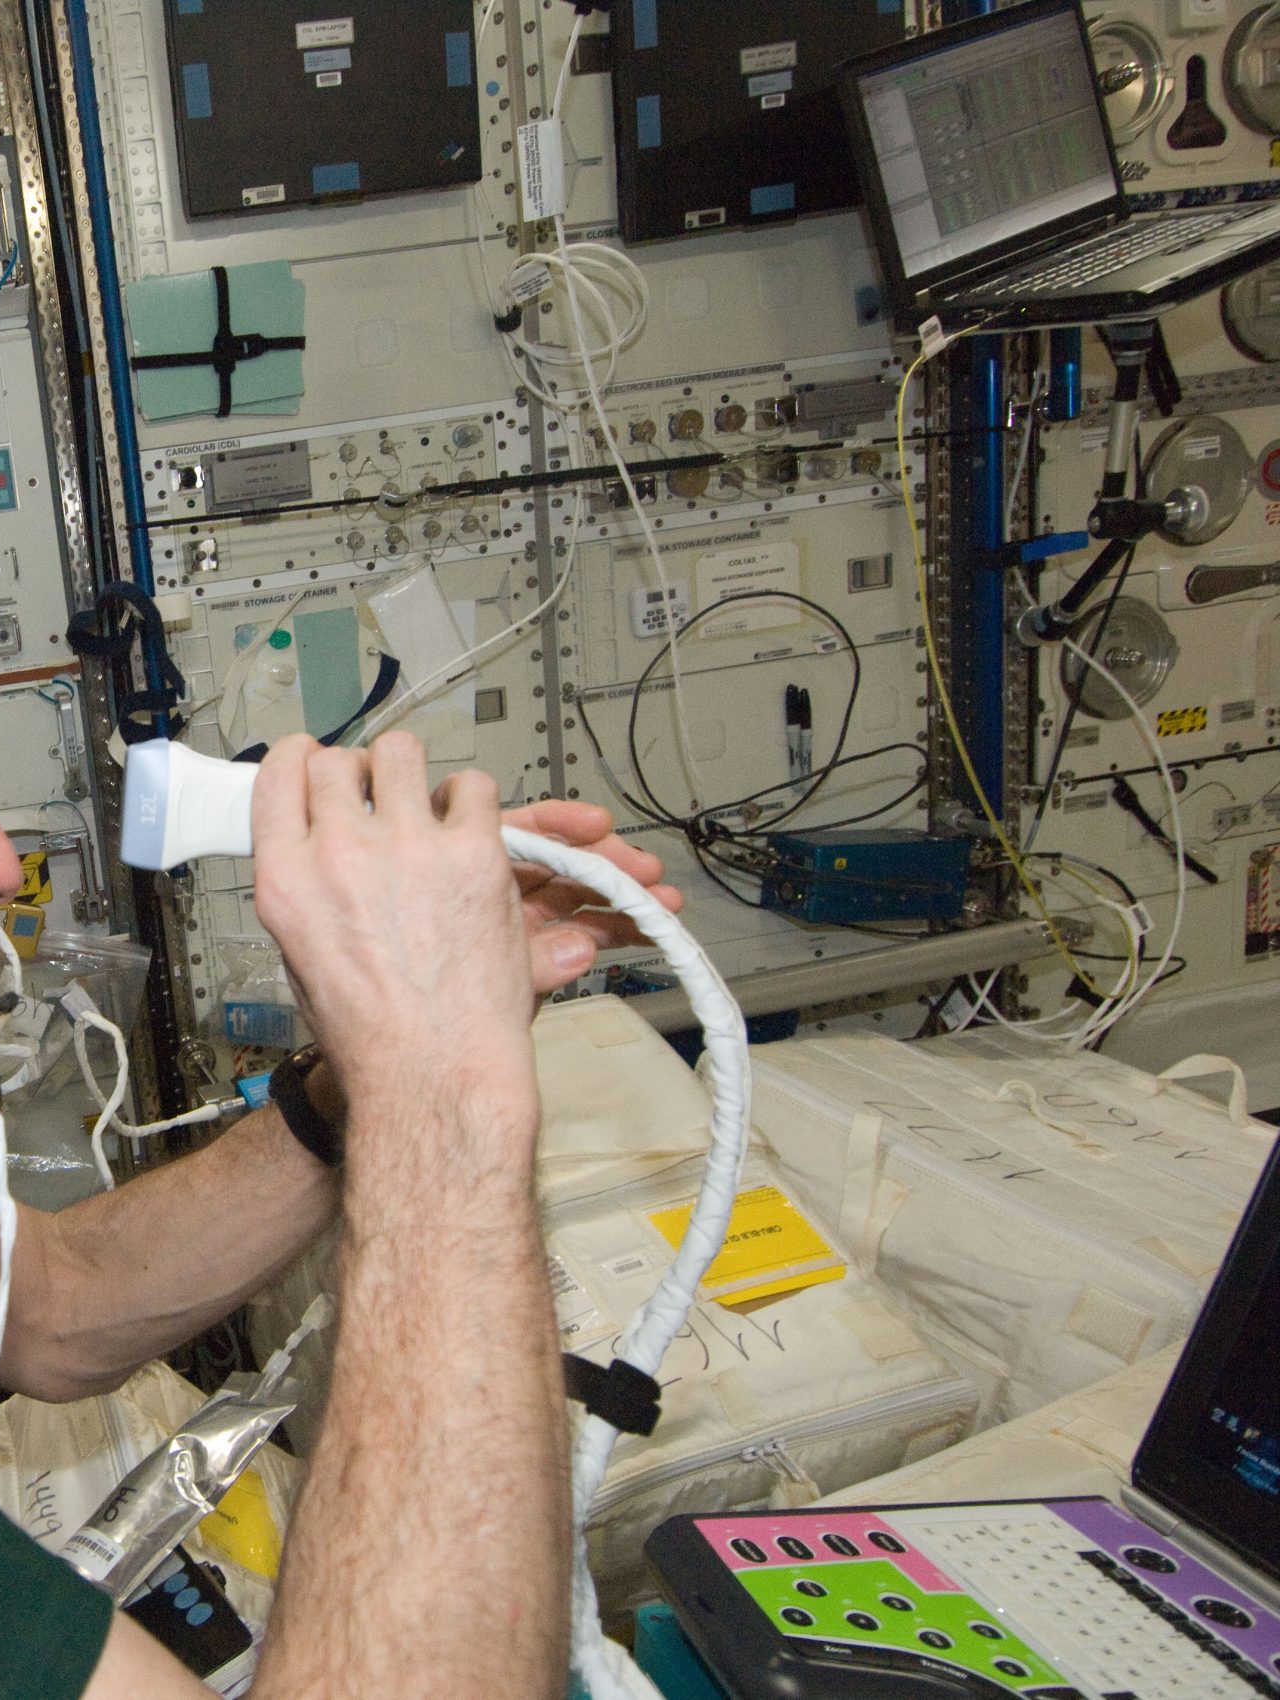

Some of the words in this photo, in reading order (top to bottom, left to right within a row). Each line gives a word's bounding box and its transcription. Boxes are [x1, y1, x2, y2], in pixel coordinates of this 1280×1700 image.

[674, 373, 712, 386] MAPPING
[165, 443, 216, 457] CARDIOLAB
[217, 439, 241, 449] (CDL)
[672, 537, 713, 552] STOWAGE
[713, 530, 762, 546] CONTAINER
[244, 594, 288, 608] STOWAGE
[140, 793, 158, 825] 12L
[627, 958, 661, 970] SERVICE
[26, 1470, 62, 1541] 1449
[920, 1659, 968, 1680] Trackball
